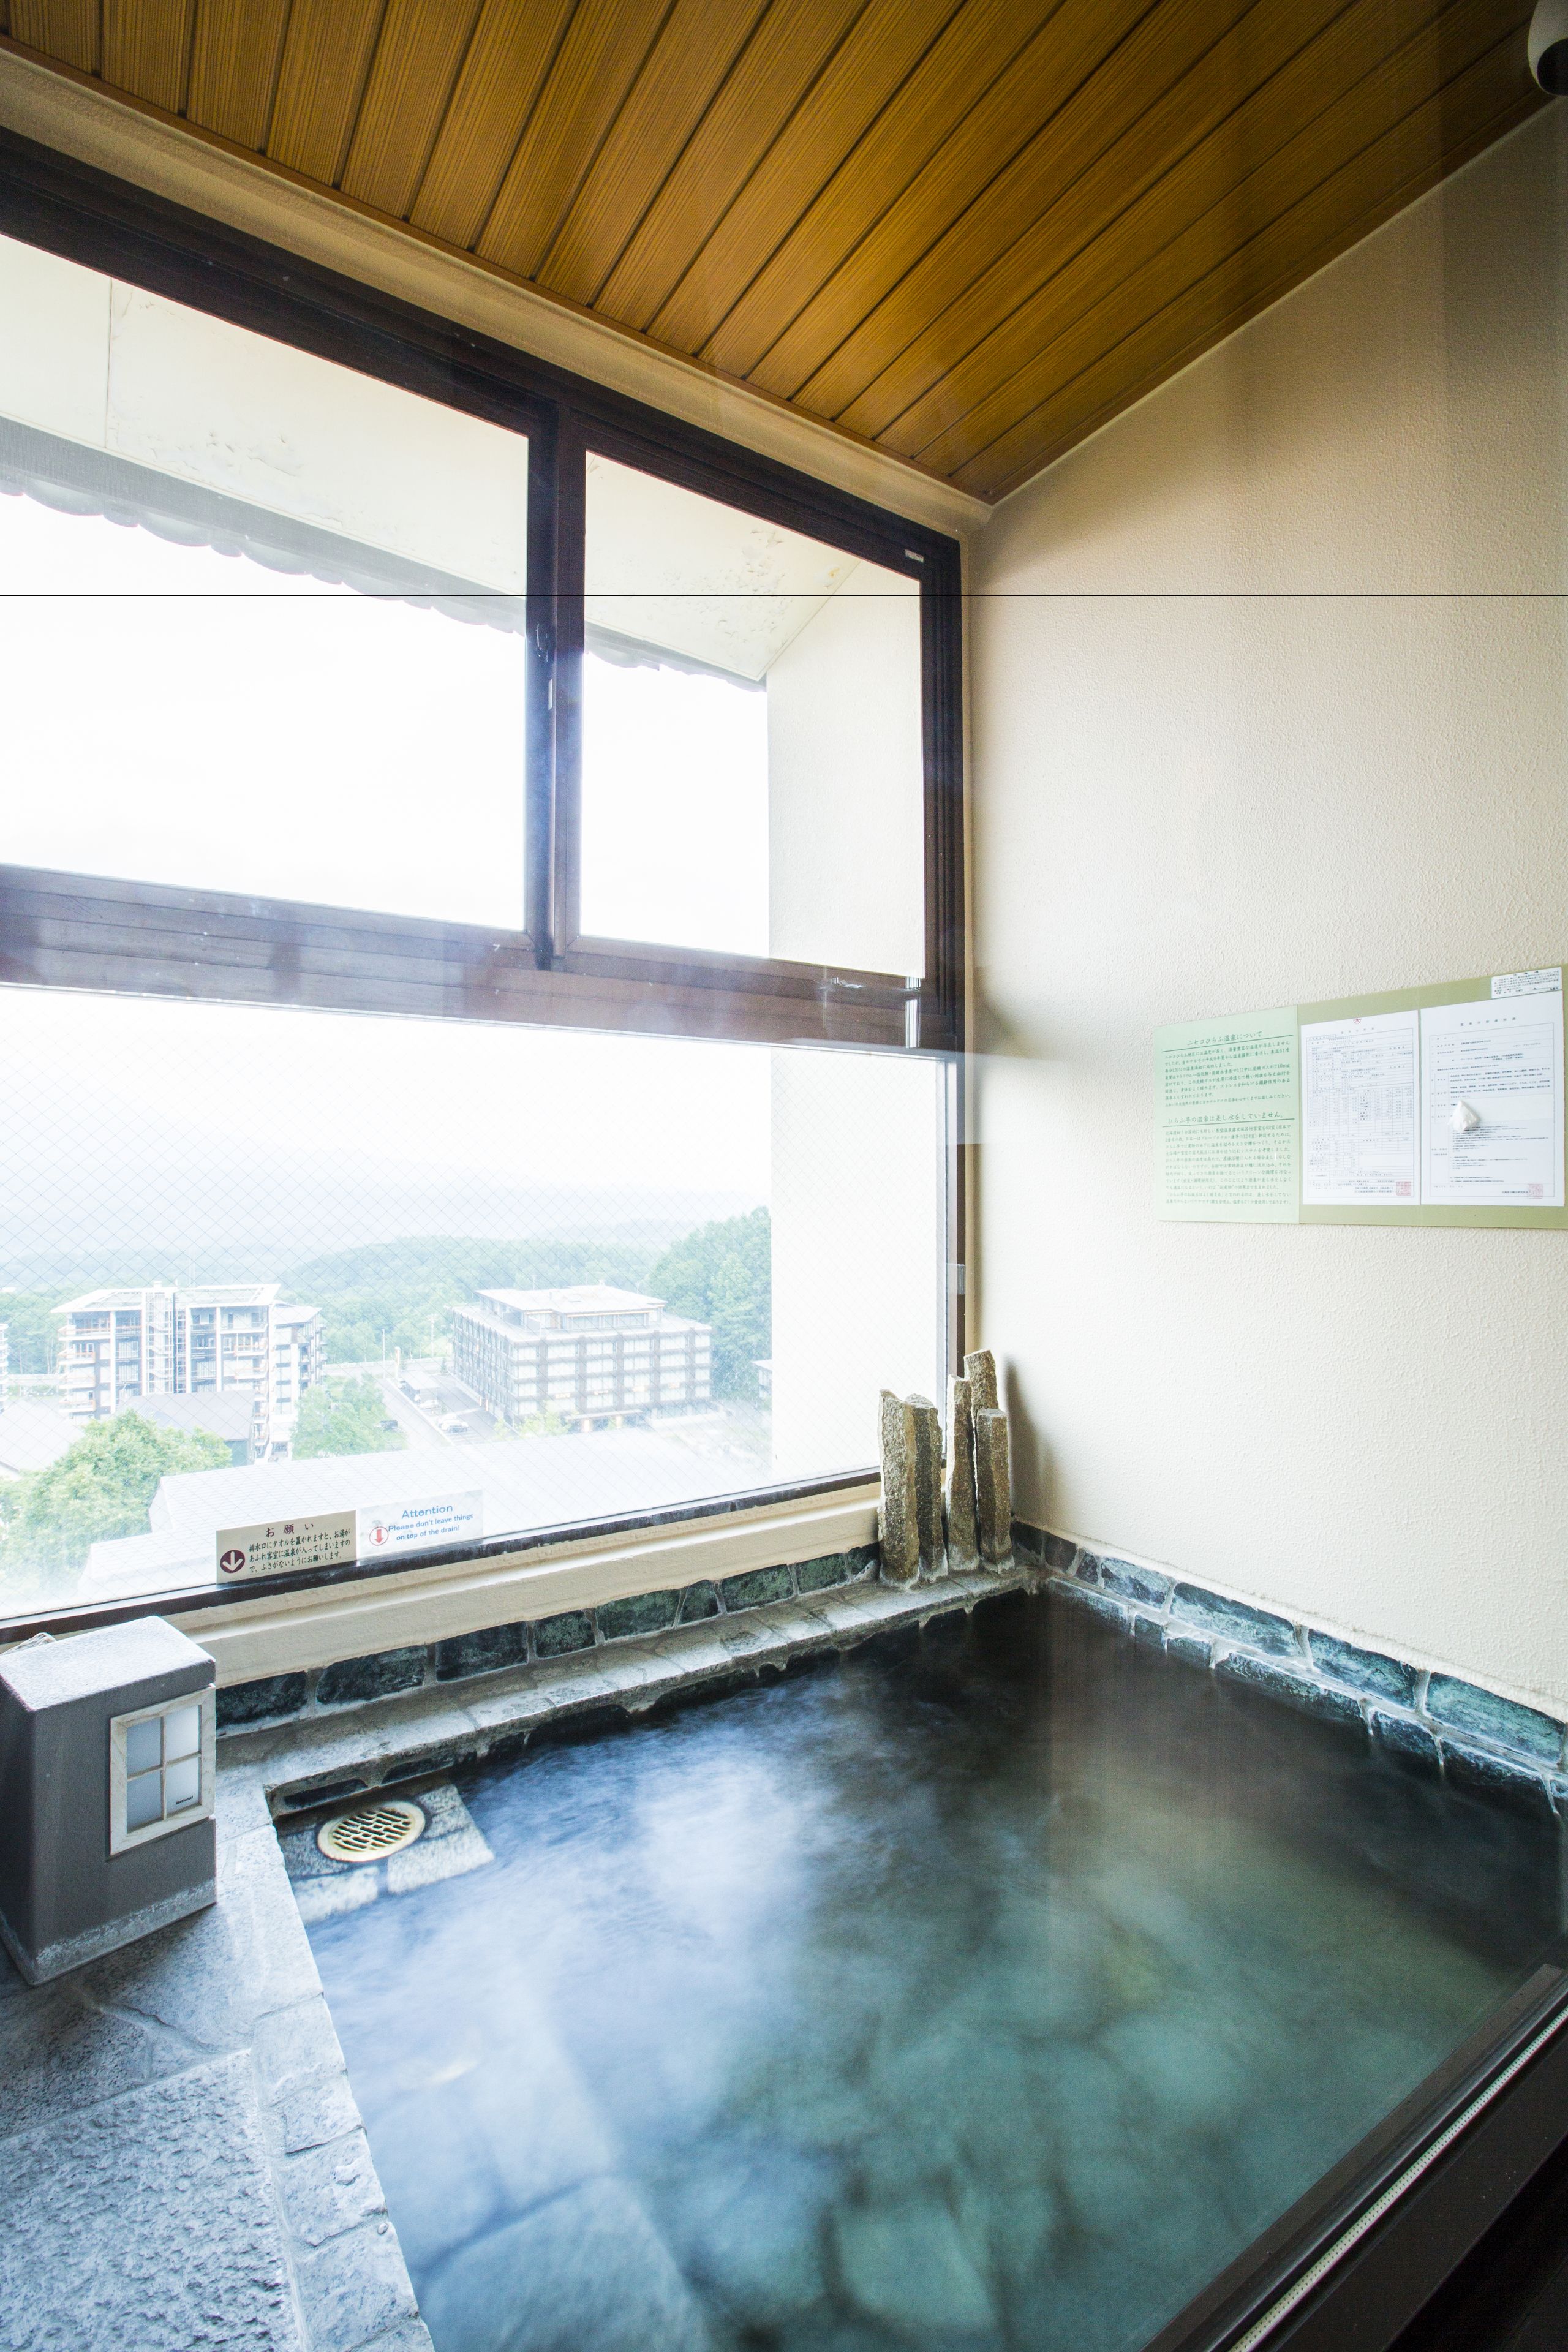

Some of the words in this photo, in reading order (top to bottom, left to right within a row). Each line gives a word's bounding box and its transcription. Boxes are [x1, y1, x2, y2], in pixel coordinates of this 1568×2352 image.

[1186, 1031, 1262, 1046] ニセコひらふ温泉について
[1167, 1112, 1284, 1125] ひらふ亭の温泉は差し水をしていません。
[401, 1505, 453, 1519] Attention
[388, 1523, 414, 1532] Please
[416, 1519, 434, 1528] don't
[454, 1513, 473, 1521] things
[440, 1525, 460, 1534] drain!
[249, 1528, 350, 1553] 排水口にタオルを置かれますと、お湯が
[249, 1539, 350, 1562] あふれ客室に温泉が入ってしまいますの
[249, 1551, 342, 1573] で、ふさがないようにお願いします。
[176, 1795, 194, 1806] National
